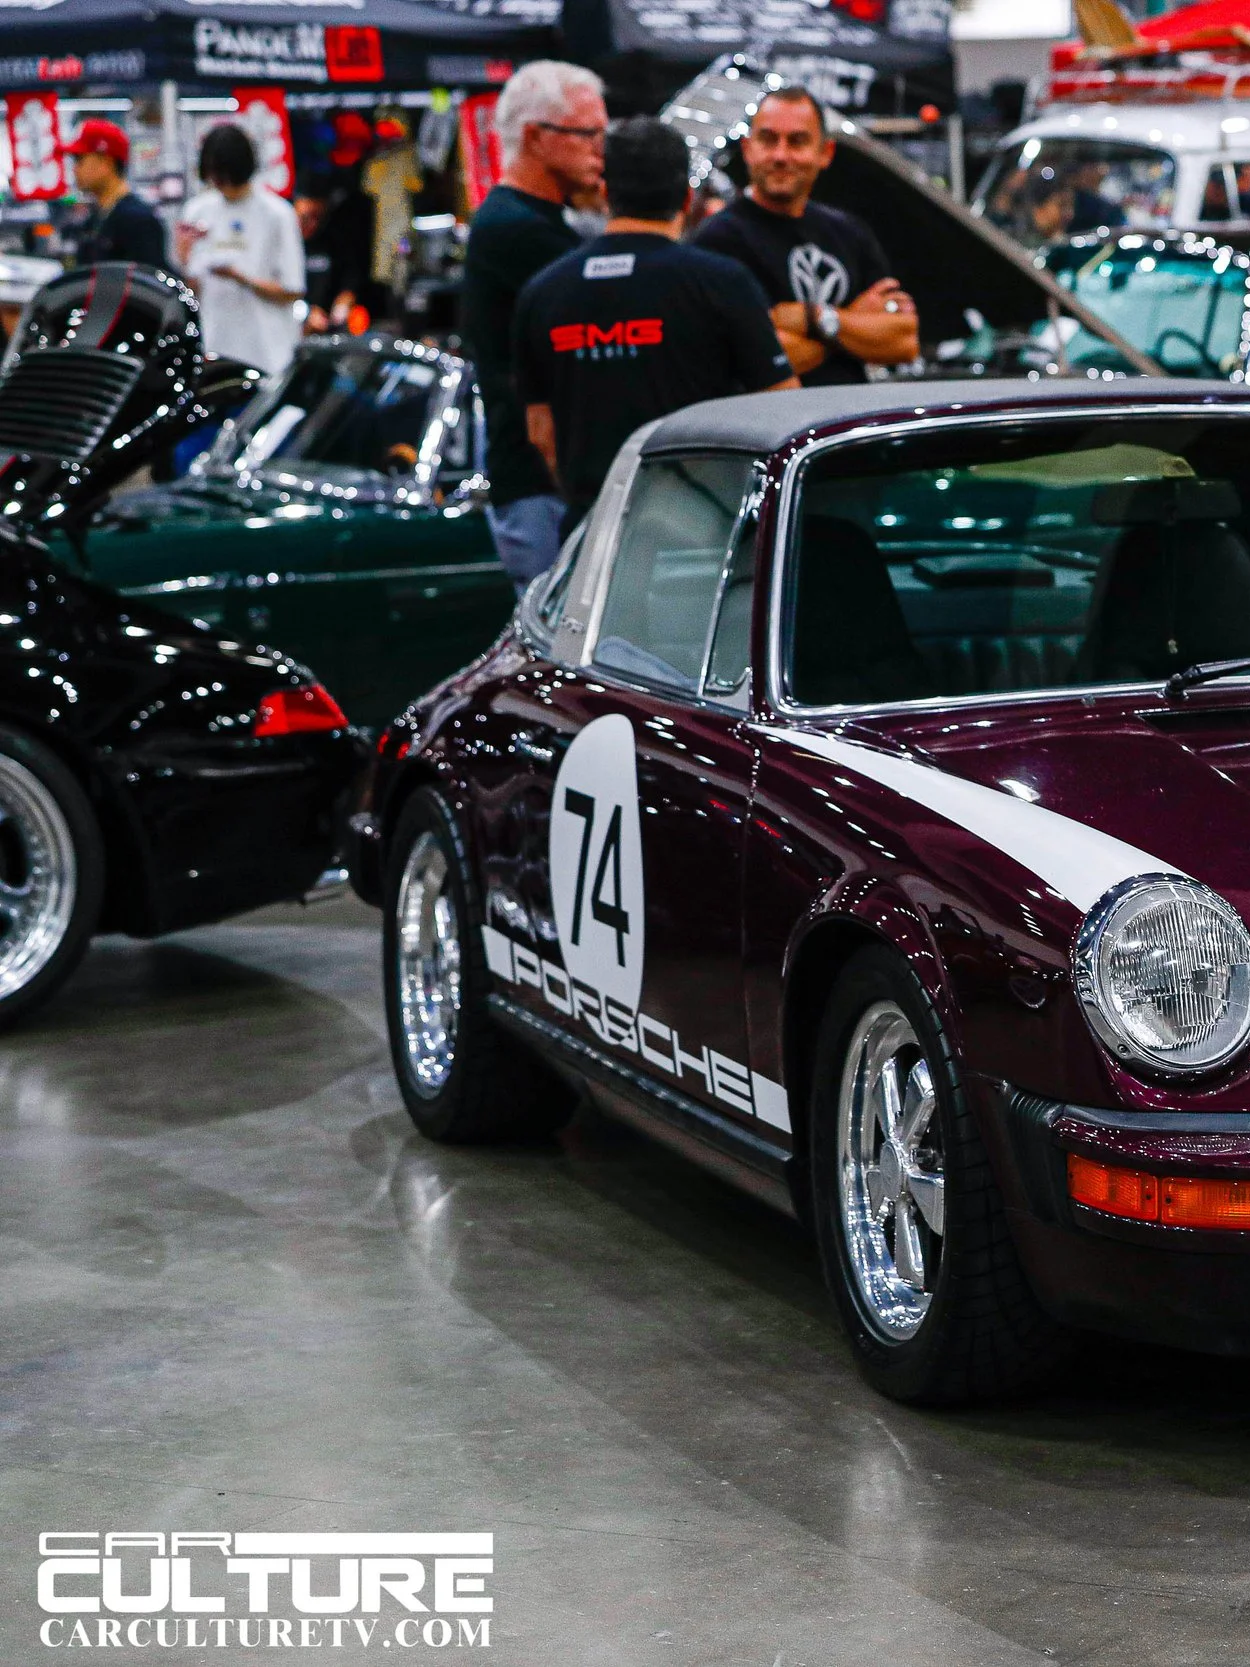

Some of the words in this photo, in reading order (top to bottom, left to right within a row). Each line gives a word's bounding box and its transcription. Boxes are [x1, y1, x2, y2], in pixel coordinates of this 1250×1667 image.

[550, 318, 664, 352] SMG
[564, 787, 630, 967] 74
[510, 942, 756, 1117] PORSCHE
